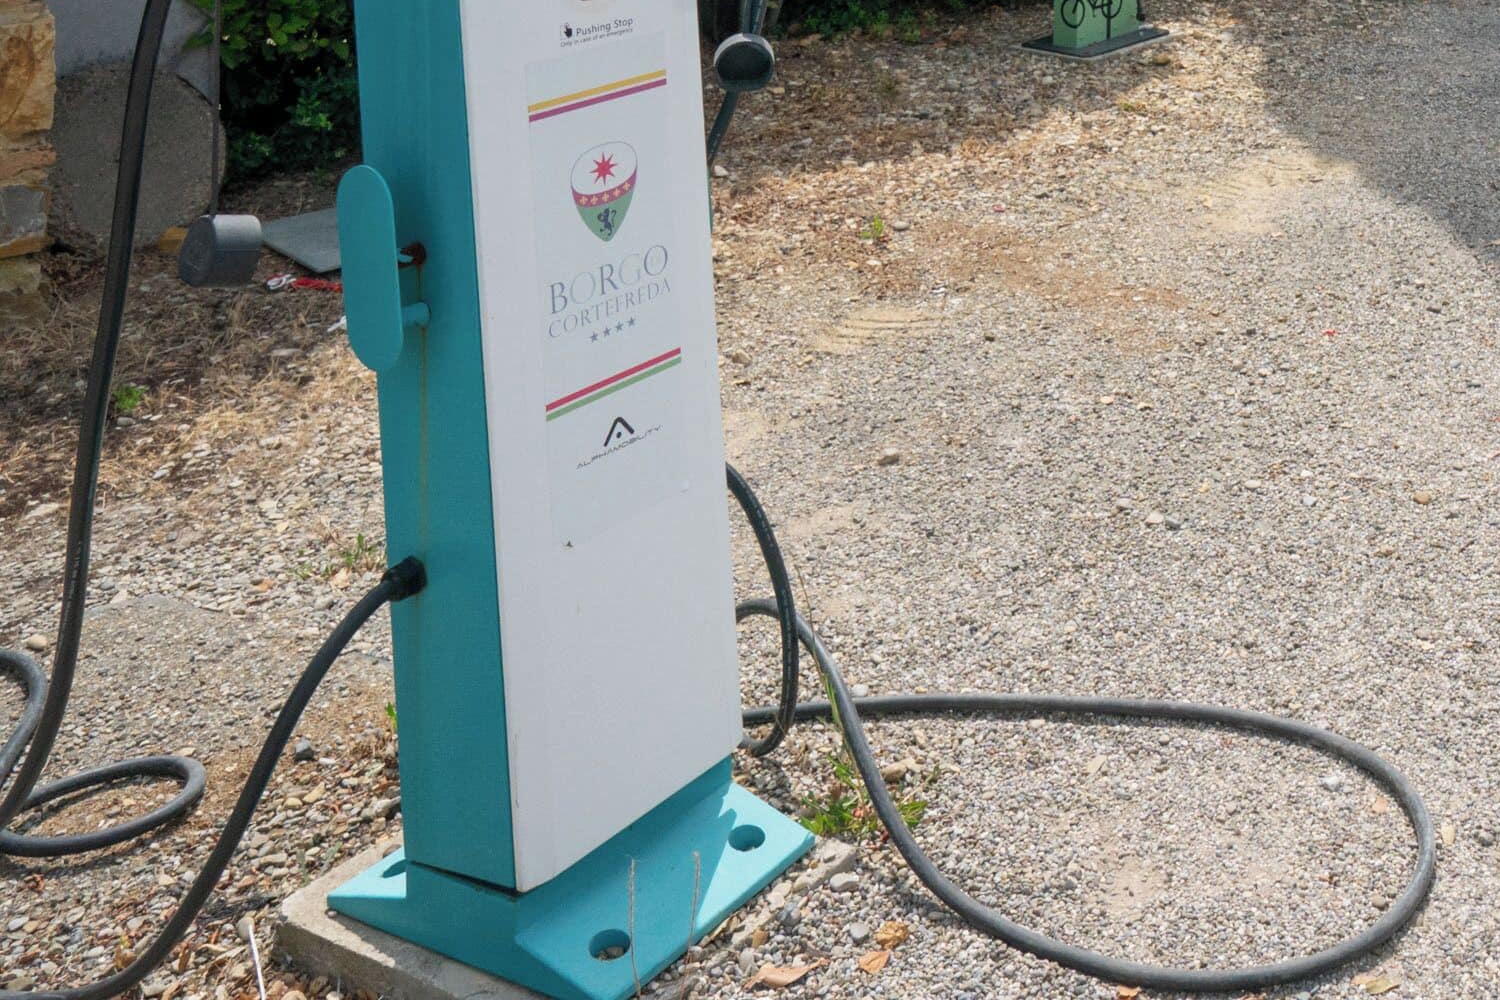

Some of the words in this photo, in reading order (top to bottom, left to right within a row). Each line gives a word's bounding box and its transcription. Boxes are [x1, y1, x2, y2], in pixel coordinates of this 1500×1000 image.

[576, 23, 611, 37] Pushing
[614, 18, 633, 28] Stop
[606, 28, 633, 37] emergency
[550, 245, 668, 314] BORGO
[549, 277, 671, 338] CORTEFREDA
[576, 424, 664, 470] ALPHAMOBILITY
